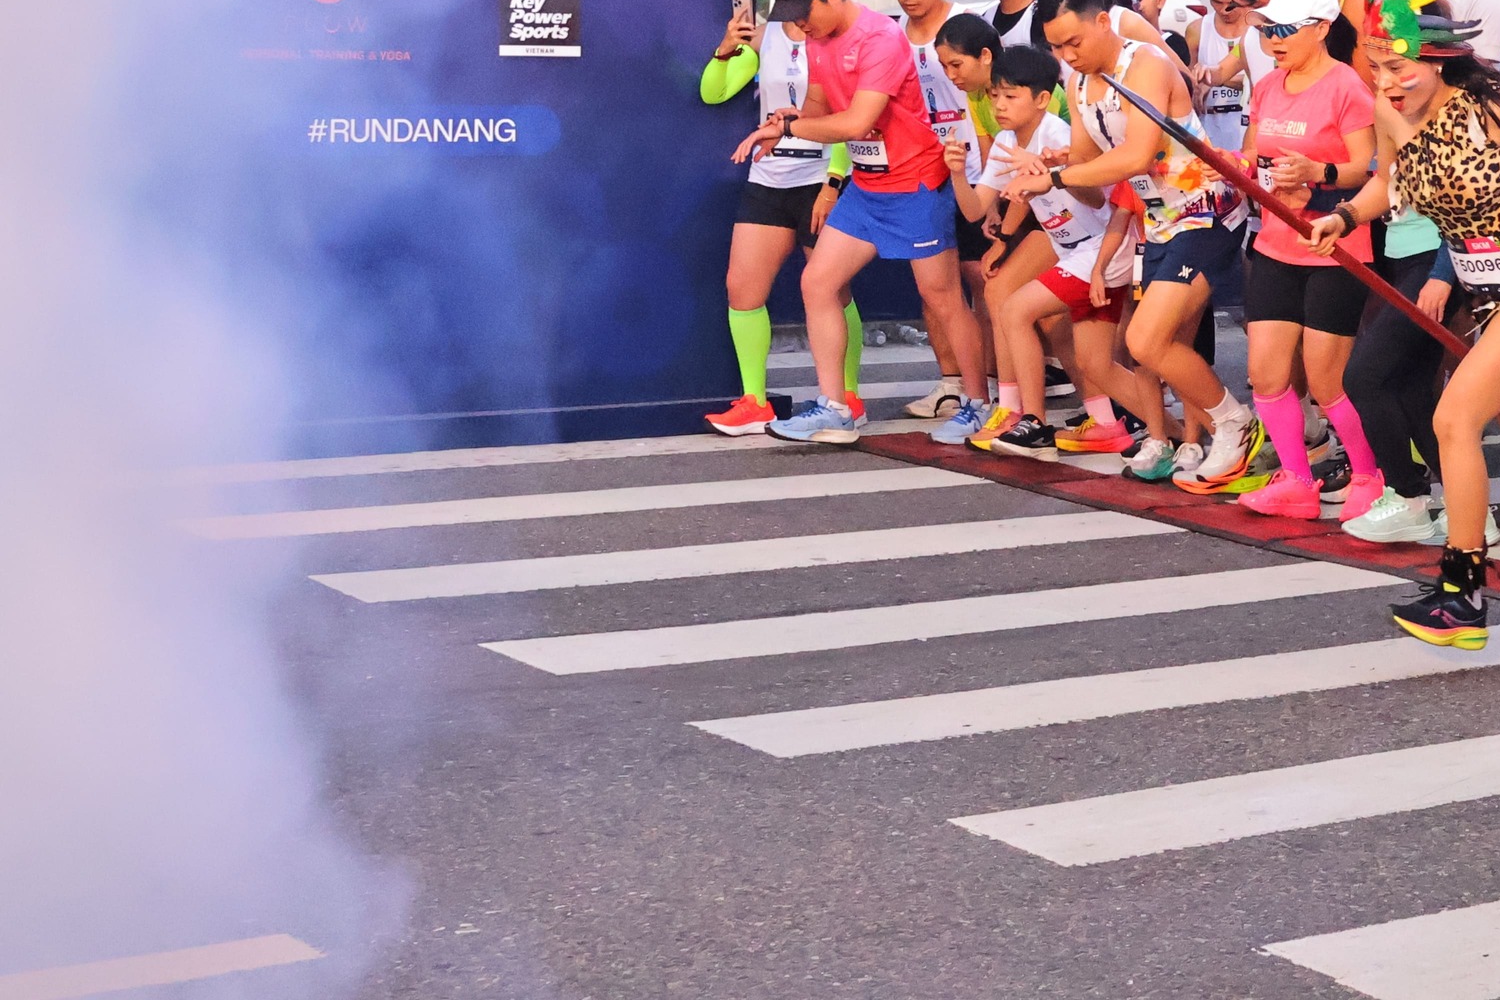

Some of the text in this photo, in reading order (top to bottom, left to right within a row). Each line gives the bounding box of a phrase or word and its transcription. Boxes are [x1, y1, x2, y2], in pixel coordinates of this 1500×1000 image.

[509, 9, 572, 25] Power
[509, 23, 569, 41] Sports
[380, 51, 412, 61] YOGA
[307, 118, 517, 143] #RUNDANANG
[850, 144, 881, 156] 50283
[1470, 241, 1491, 250] 5KM
